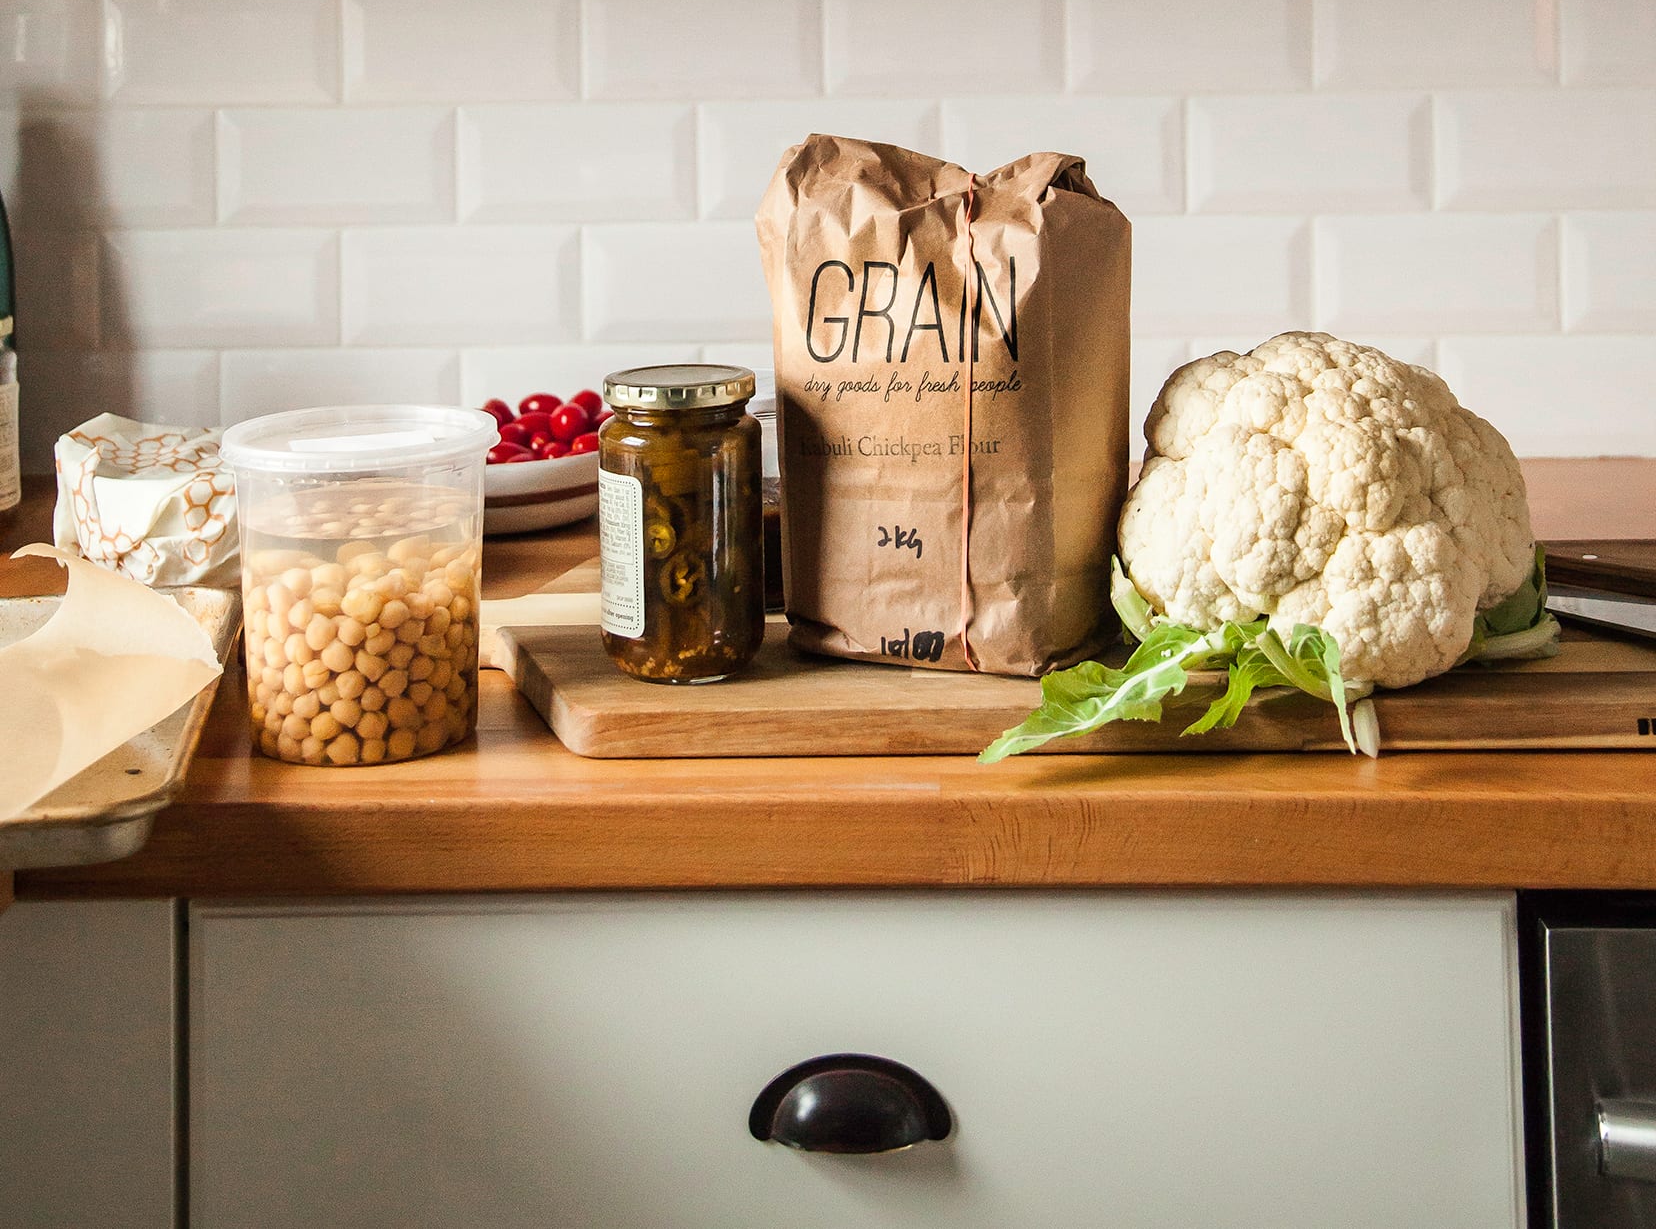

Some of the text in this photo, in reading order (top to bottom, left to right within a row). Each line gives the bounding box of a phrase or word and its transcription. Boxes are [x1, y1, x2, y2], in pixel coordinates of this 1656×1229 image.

[806, 256, 1018, 363] GRAIN
[804, 373, 832, 402] dry
[836, 373, 881, 402] goods
[884, 370, 912, 402] for
[915, 370, 960, 402] fresh
[858, 435, 942, 463] Chickpea
